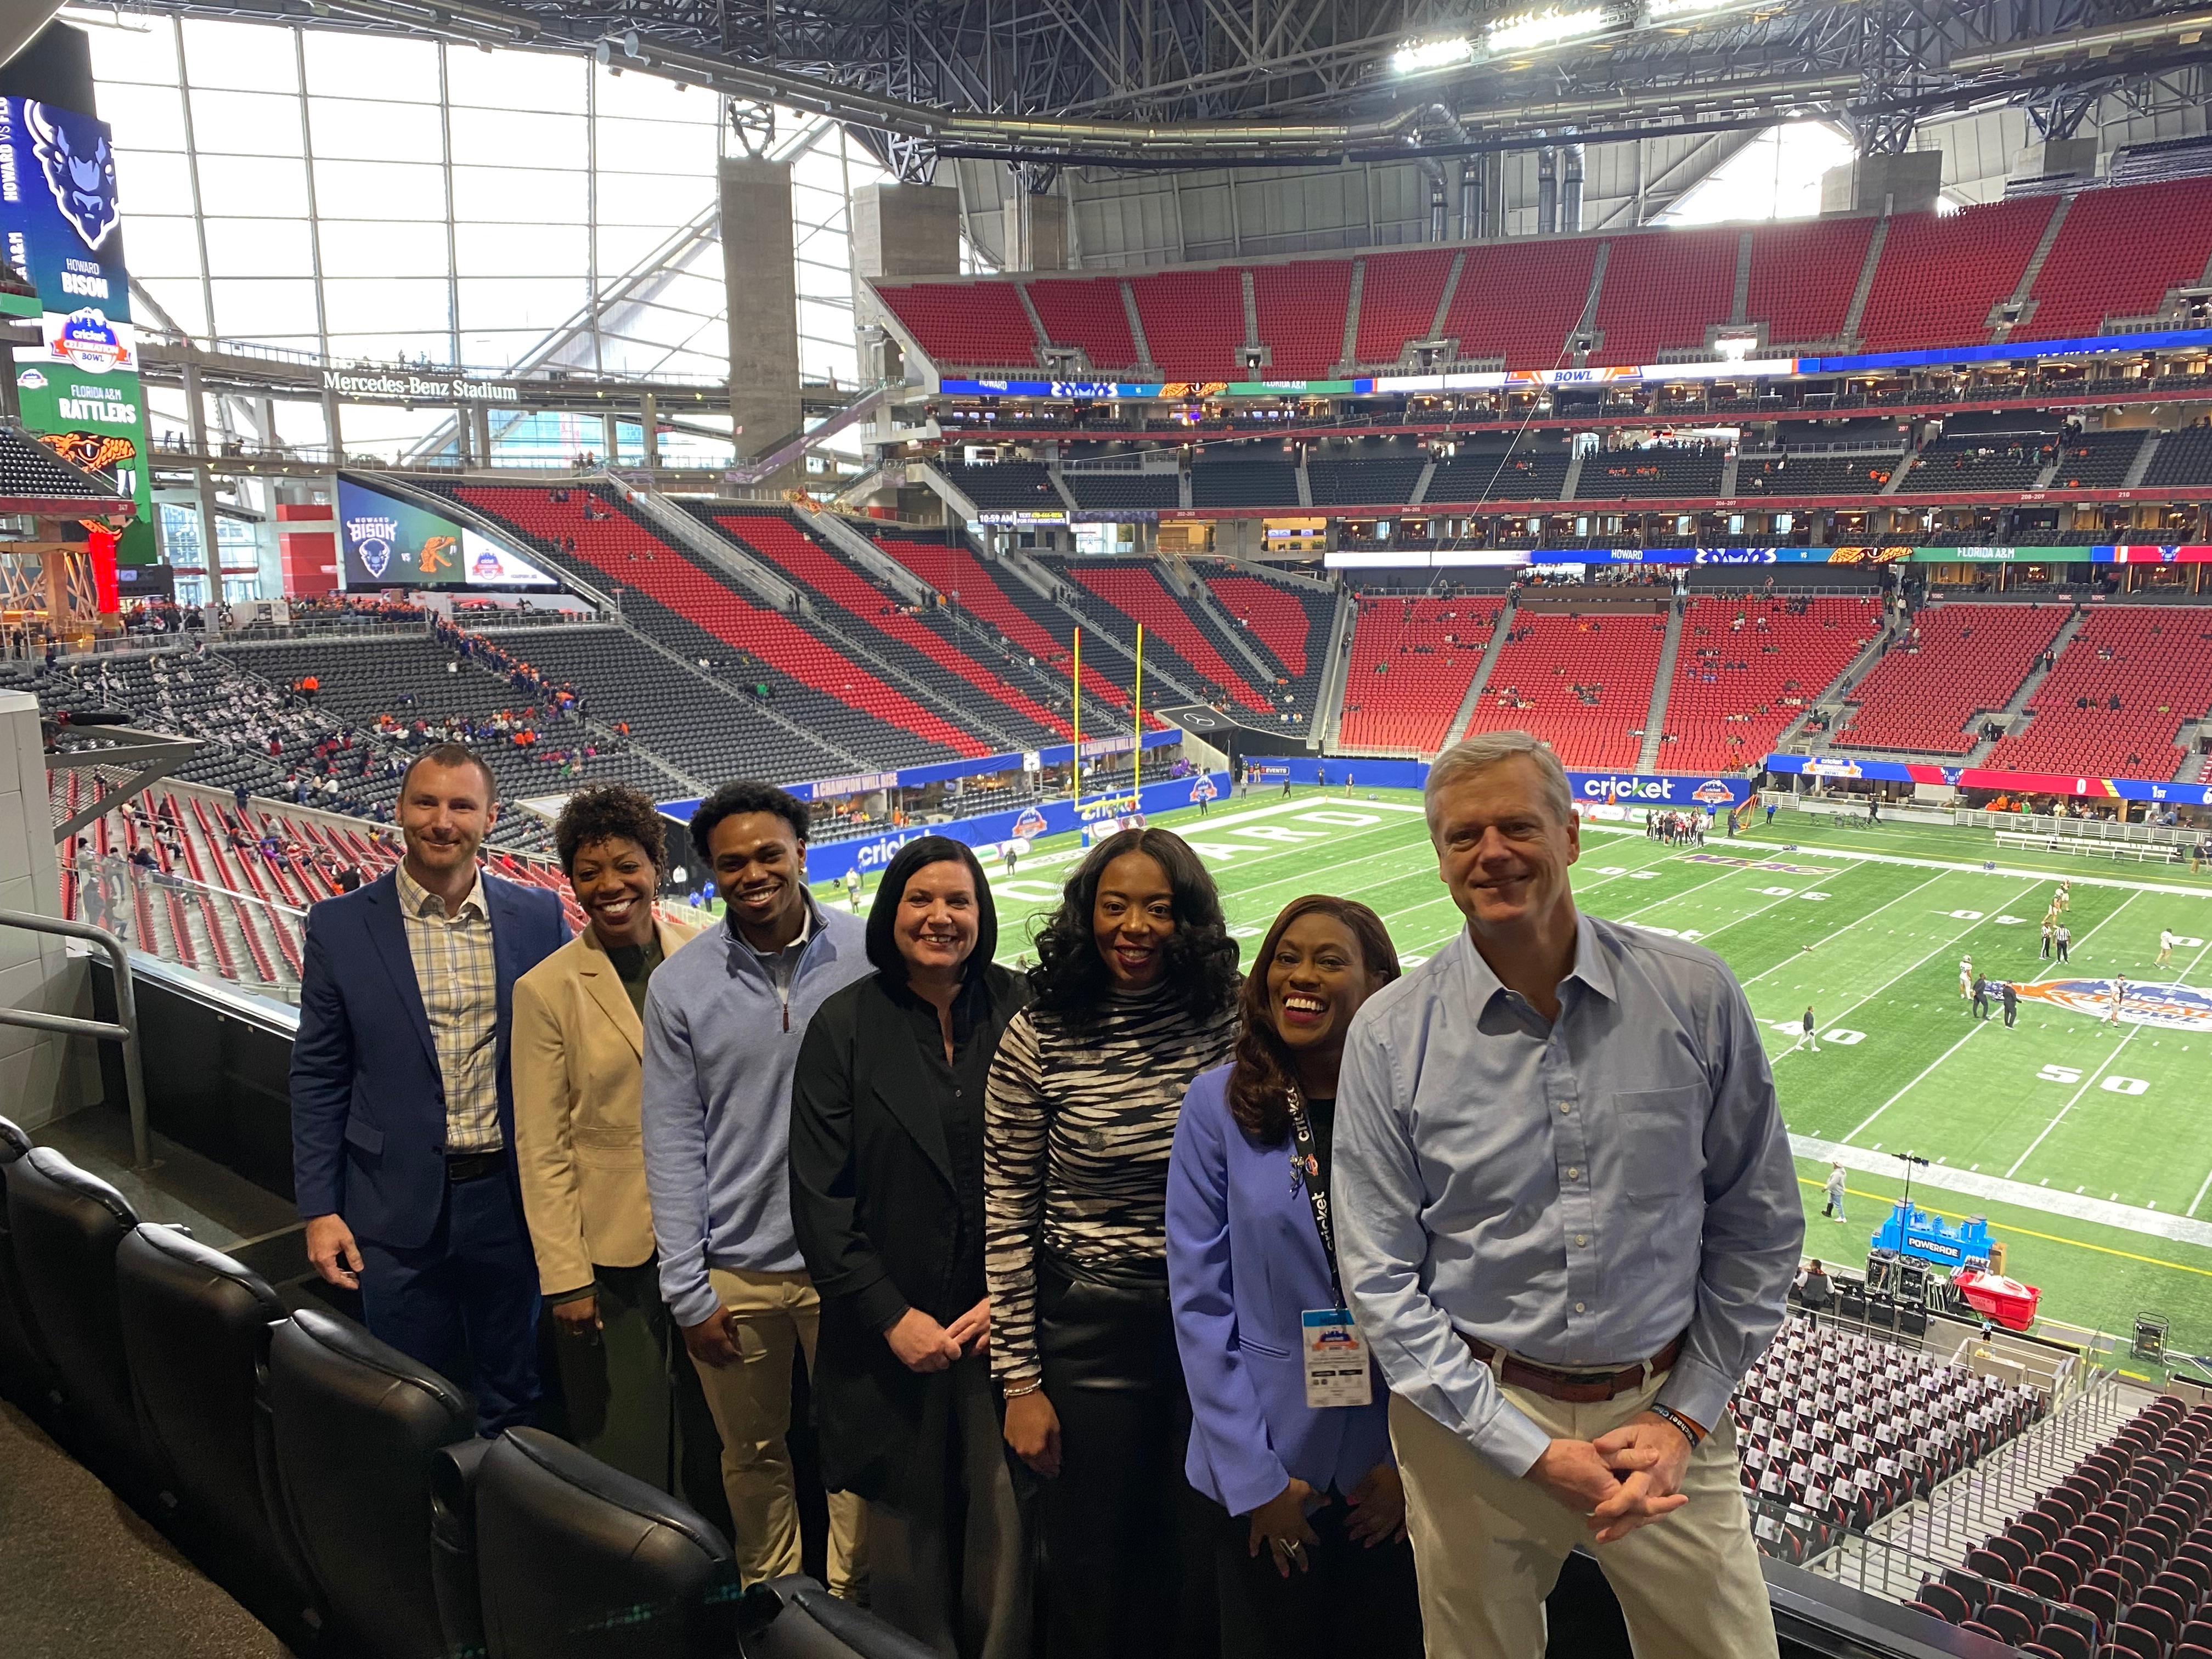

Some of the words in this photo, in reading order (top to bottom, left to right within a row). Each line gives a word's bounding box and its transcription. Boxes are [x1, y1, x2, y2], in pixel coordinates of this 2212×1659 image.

[0, 144, 18, 201] HOWARD
[66, 258, 99, 275] HOWARD
[61, 271, 108, 299] BISON
[72, 330, 106, 342] cricket
[82, 353, 104, 362] BOWL
[323, 371, 449, 396] Mercedes-Benz
[453, 379, 517, 400] Stadium
[1554, 371, 1593, 382] BOWL
[71, 385, 104, 399] FLORIDA
[105, 388, 122, 400] A&M
[59, 398, 136, 424] RATTLERS
[979, 514, 1000, 523] 10:59
[1001, 515, 1013, 523] AM
[348, 522, 396, 542] BISON
[401, 553, 411, 562] VS
[1611, 549, 1643, 560] HOWARD
[1957, 547, 1994, 558] FLORIDA
[1995, 548, 2015, 559] A&M
[1086, 740, 1115, 755] CHAMPION
[812, 783, 819, 798] A
[820, 777, 861, 797] CHAMPION
[862, 775, 880, 791] WILL
[881, 772, 898, 788] RISE
[1584, 776, 1673, 799] cricket
[2076, 778, 2086, 794] 0
[2152, 785, 2166, 799] 1ST
[858, 829, 935, 867] cric
[1671, 854, 1842, 875] MEAC
[1312, 1191, 1334, 1251] cricket
[1908, 1238, 1959, 1257] POWERADE
[1669, 1415, 1693, 1440] Michael
